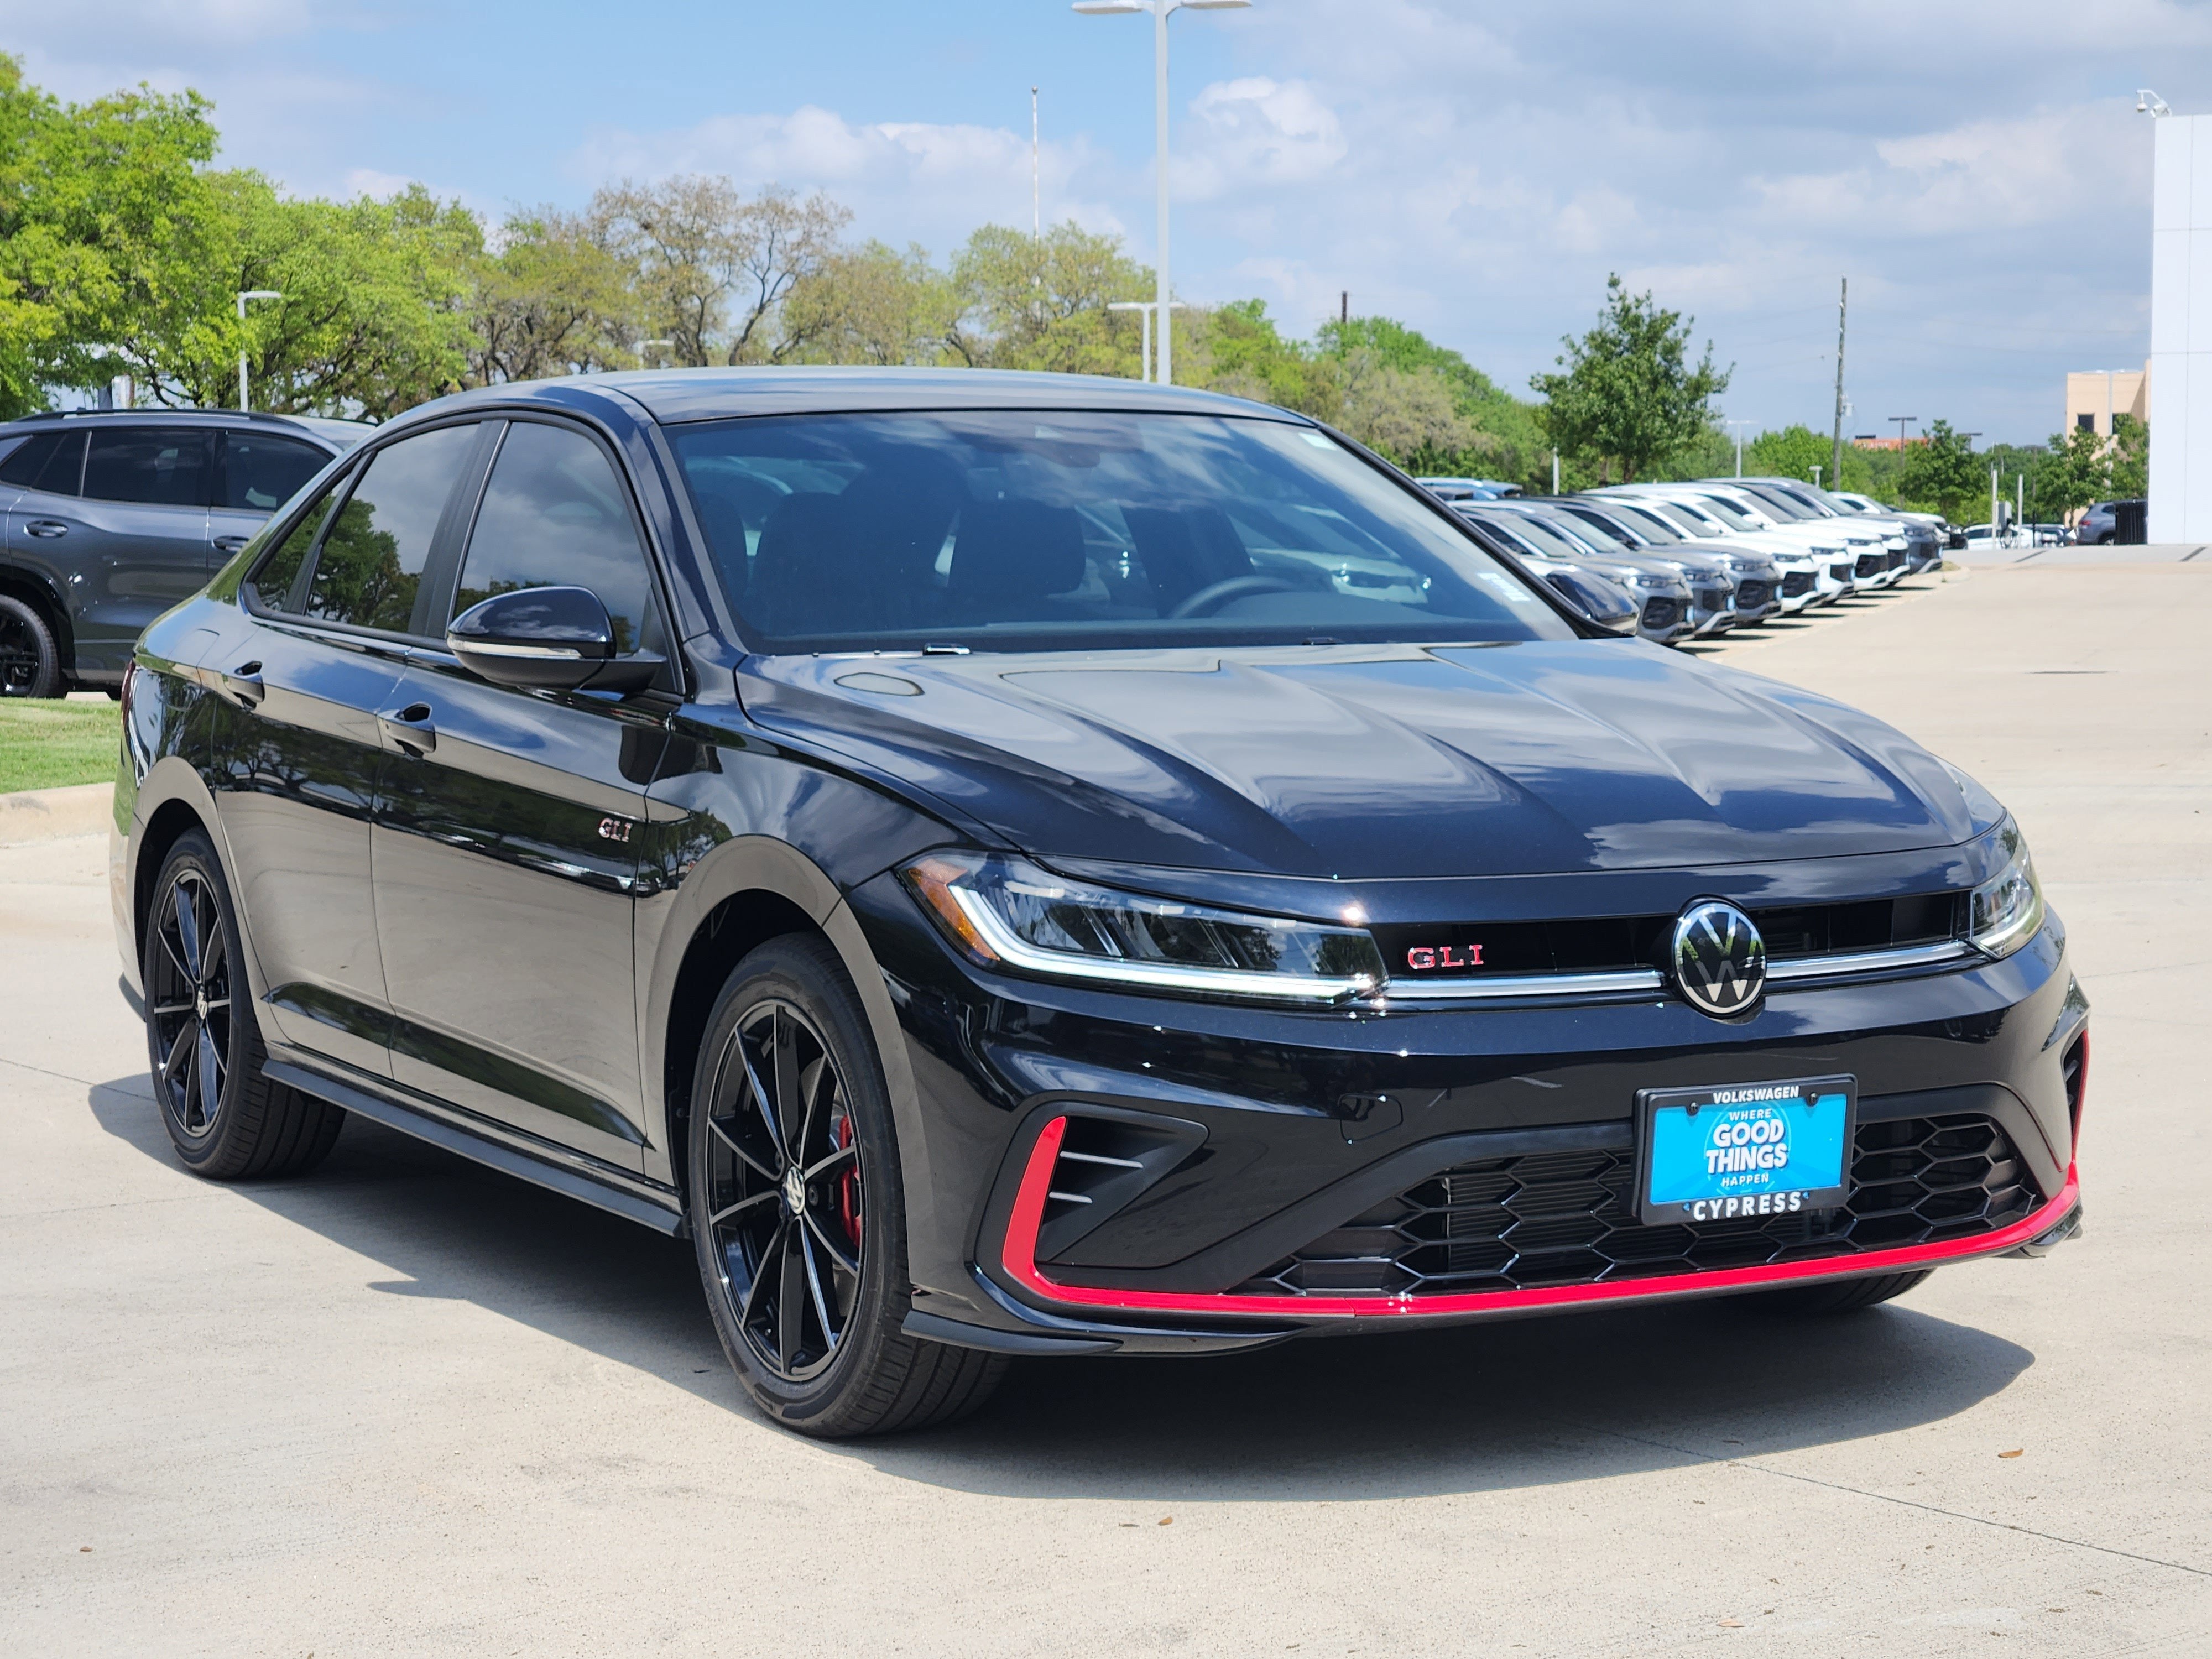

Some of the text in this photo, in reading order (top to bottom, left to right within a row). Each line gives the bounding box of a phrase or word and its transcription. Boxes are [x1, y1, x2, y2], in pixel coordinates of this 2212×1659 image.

[598, 818, 633, 842] GLI
[1408, 945, 1483, 969] GLI
[1713, 1086, 1799, 1104] VOLKSWAGEN
[1729, 1108, 1772, 1121] WHERE
[1713, 1118, 1785, 1147] GOOD
[1705, 1143, 1788, 1173] THINGS
[1721, 1172, 1770, 1187] HAPPEN
[1693, 1192, 1801, 1221] CYPRESS
